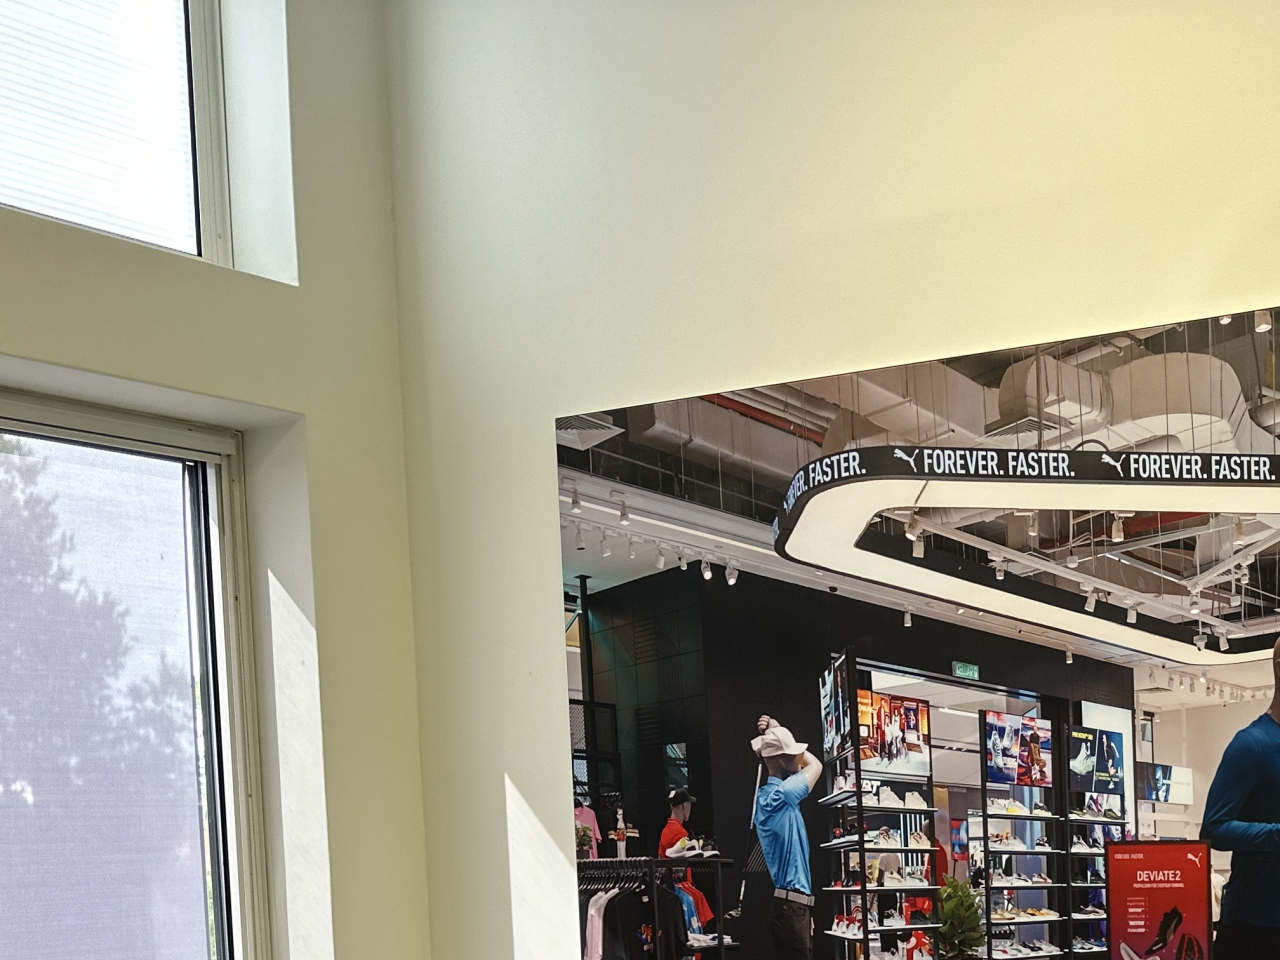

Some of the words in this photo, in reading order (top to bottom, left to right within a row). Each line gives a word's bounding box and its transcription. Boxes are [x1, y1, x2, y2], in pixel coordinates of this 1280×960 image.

[808, 451, 867, 488] FASTER.
[923, 449, 1004, 475] FOREVER.
[1008, 452, 1075, 477] FASTER.
[1130, 454, 1208, 479] FOREVER.
[1211, 455, 1276, 480] FASTER.
[1136, 870, 1175, 881] DEVIATE
[1175, 870, 1181, 881] 2
